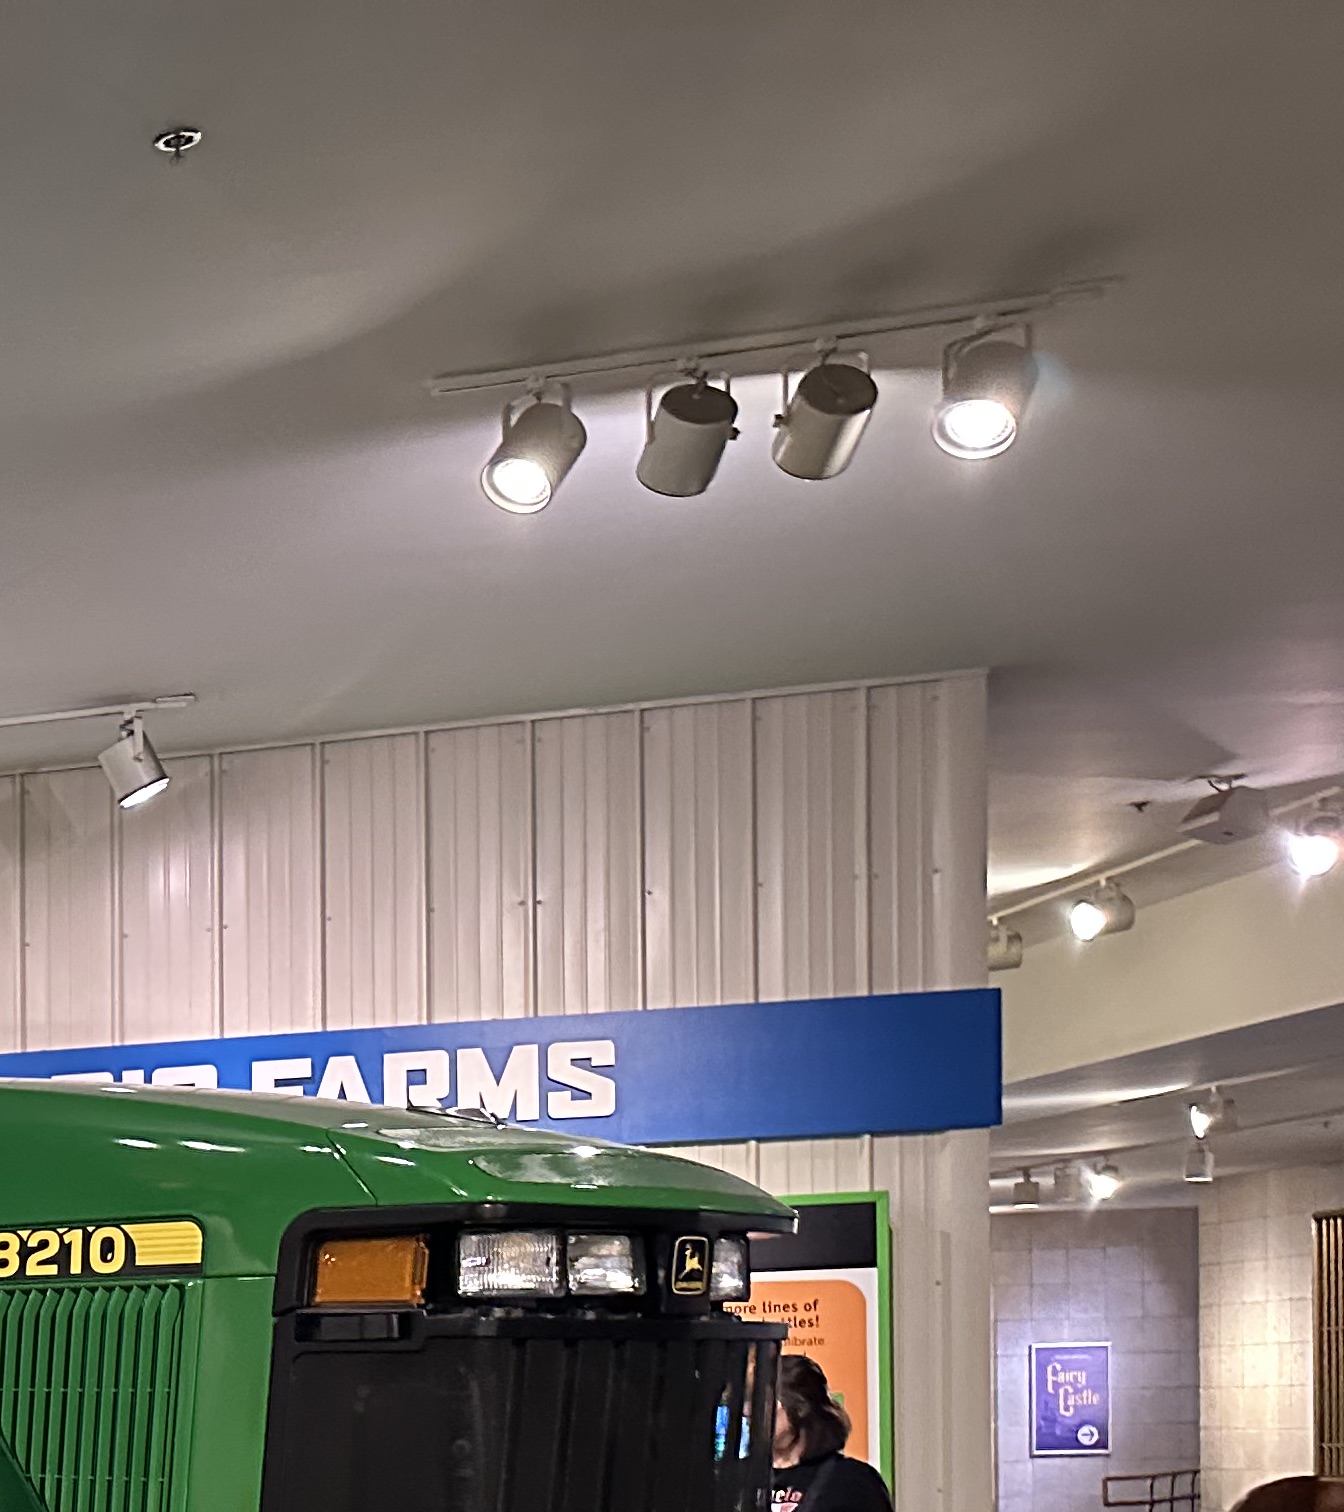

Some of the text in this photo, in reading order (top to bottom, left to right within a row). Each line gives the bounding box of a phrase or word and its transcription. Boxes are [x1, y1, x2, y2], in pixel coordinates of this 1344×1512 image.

[762, 1301, 799, 1314] lines
[803, 1299, 820, 1312] of
[1047, 1362, 1086, 1394] Fairy
[1059, 1385, 1100, 1417] Castle
